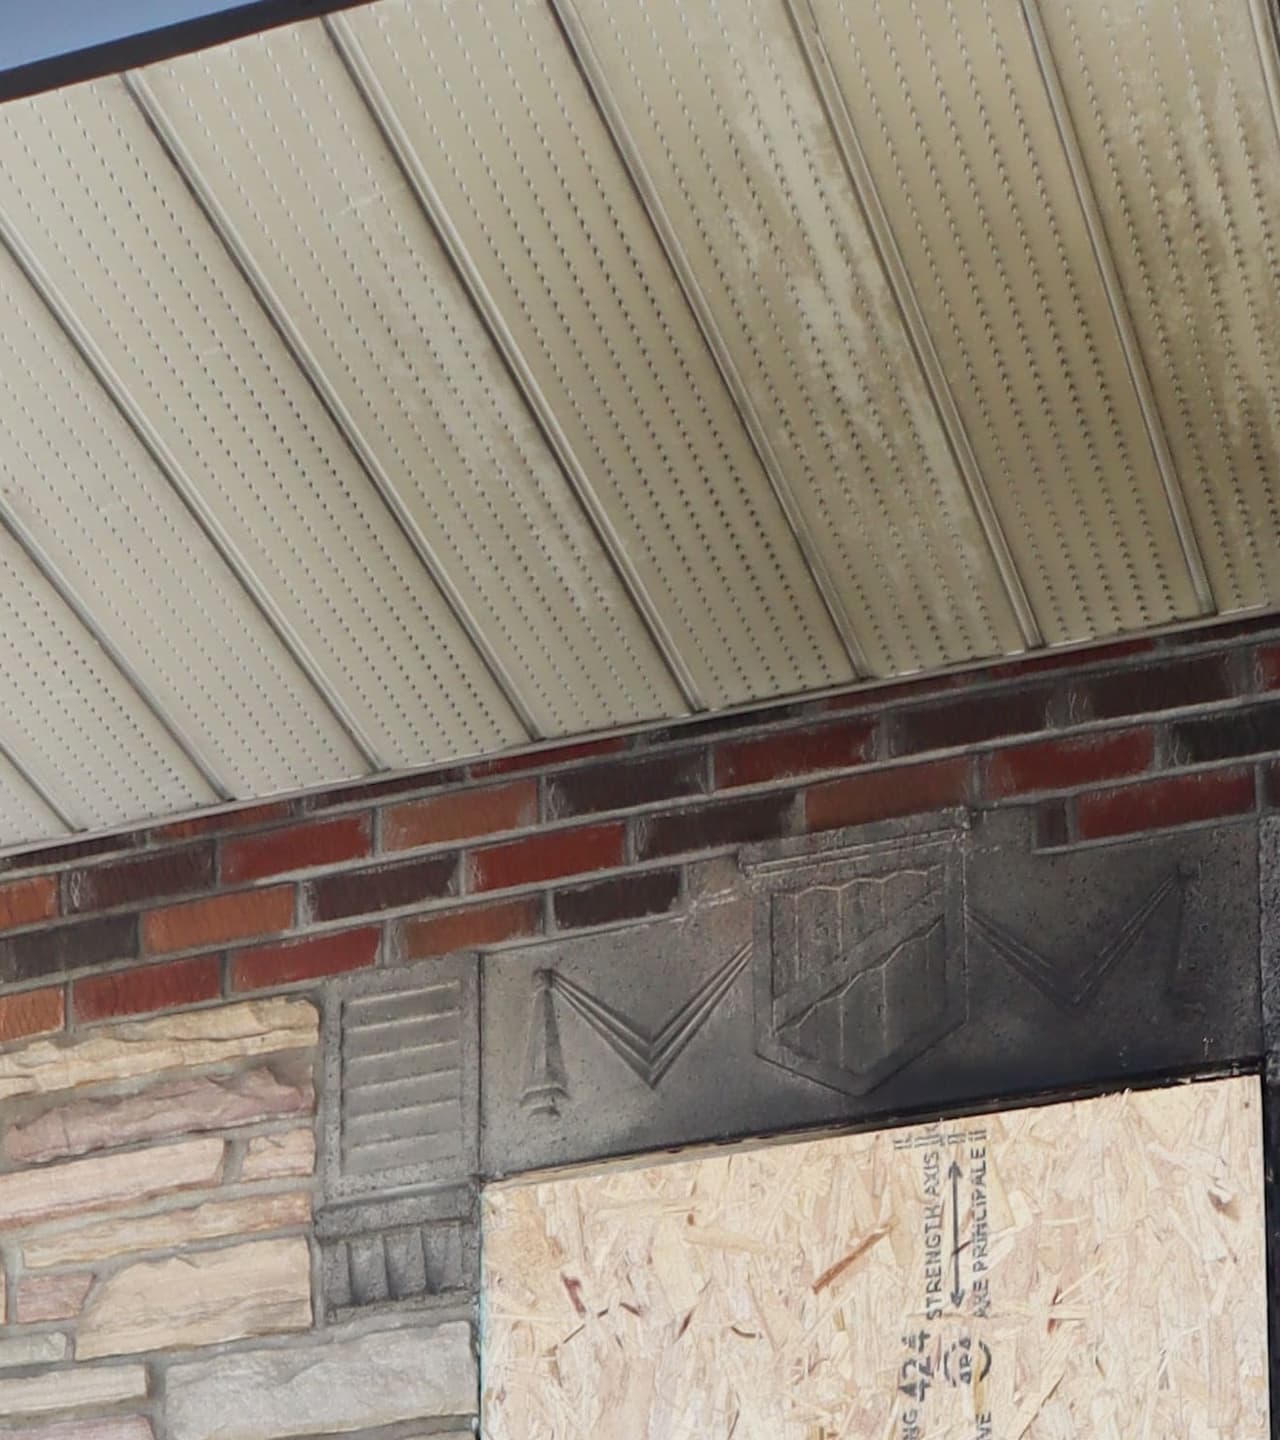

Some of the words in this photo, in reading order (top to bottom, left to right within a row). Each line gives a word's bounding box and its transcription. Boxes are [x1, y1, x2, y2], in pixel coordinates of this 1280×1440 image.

[923, 1151, 940, 1196] AXIS
[970, 1148, 988, 1272] PRINCIPALE
[924, 1205, 942, 1320] STRENGTH
